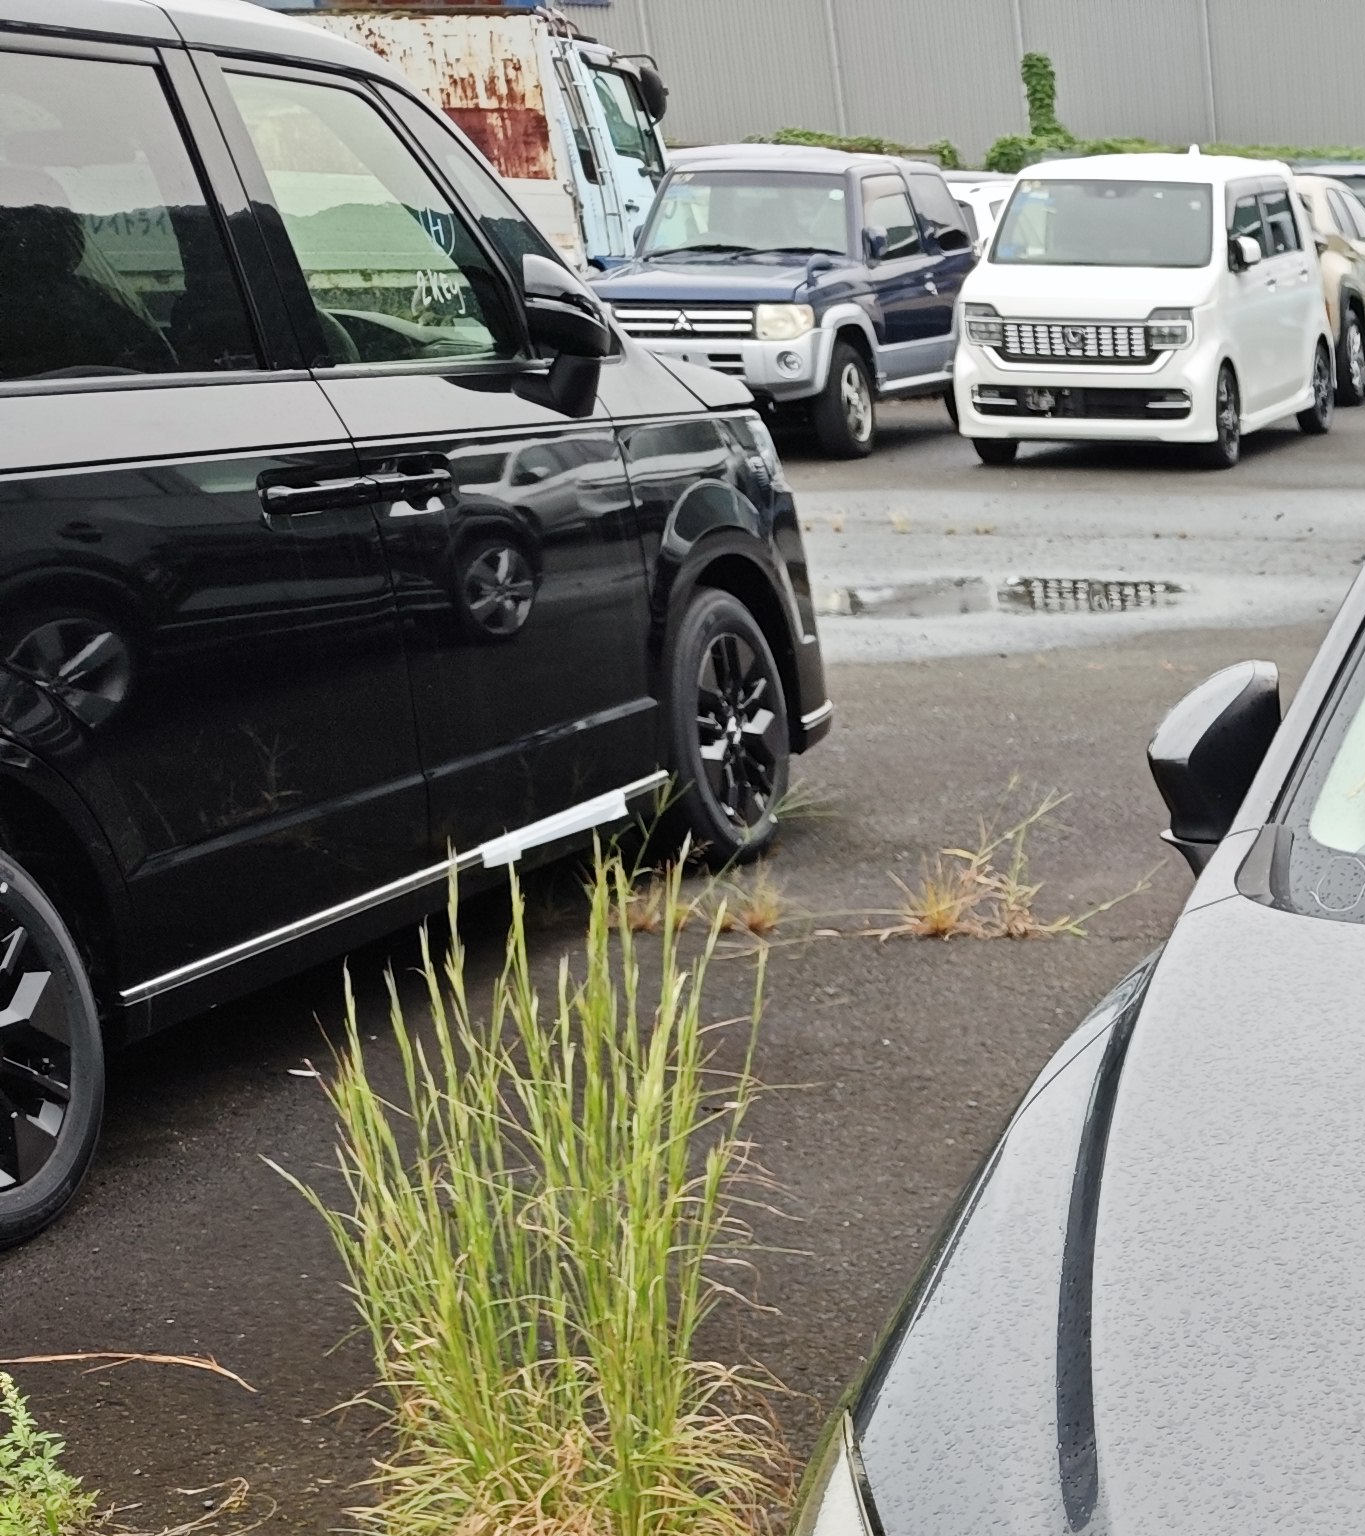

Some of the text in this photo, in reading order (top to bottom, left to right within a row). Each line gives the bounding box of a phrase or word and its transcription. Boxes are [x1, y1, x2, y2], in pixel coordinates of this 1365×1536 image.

[80, 206, 167, 236] レイトライ
[425, 206, 445, 246] H
